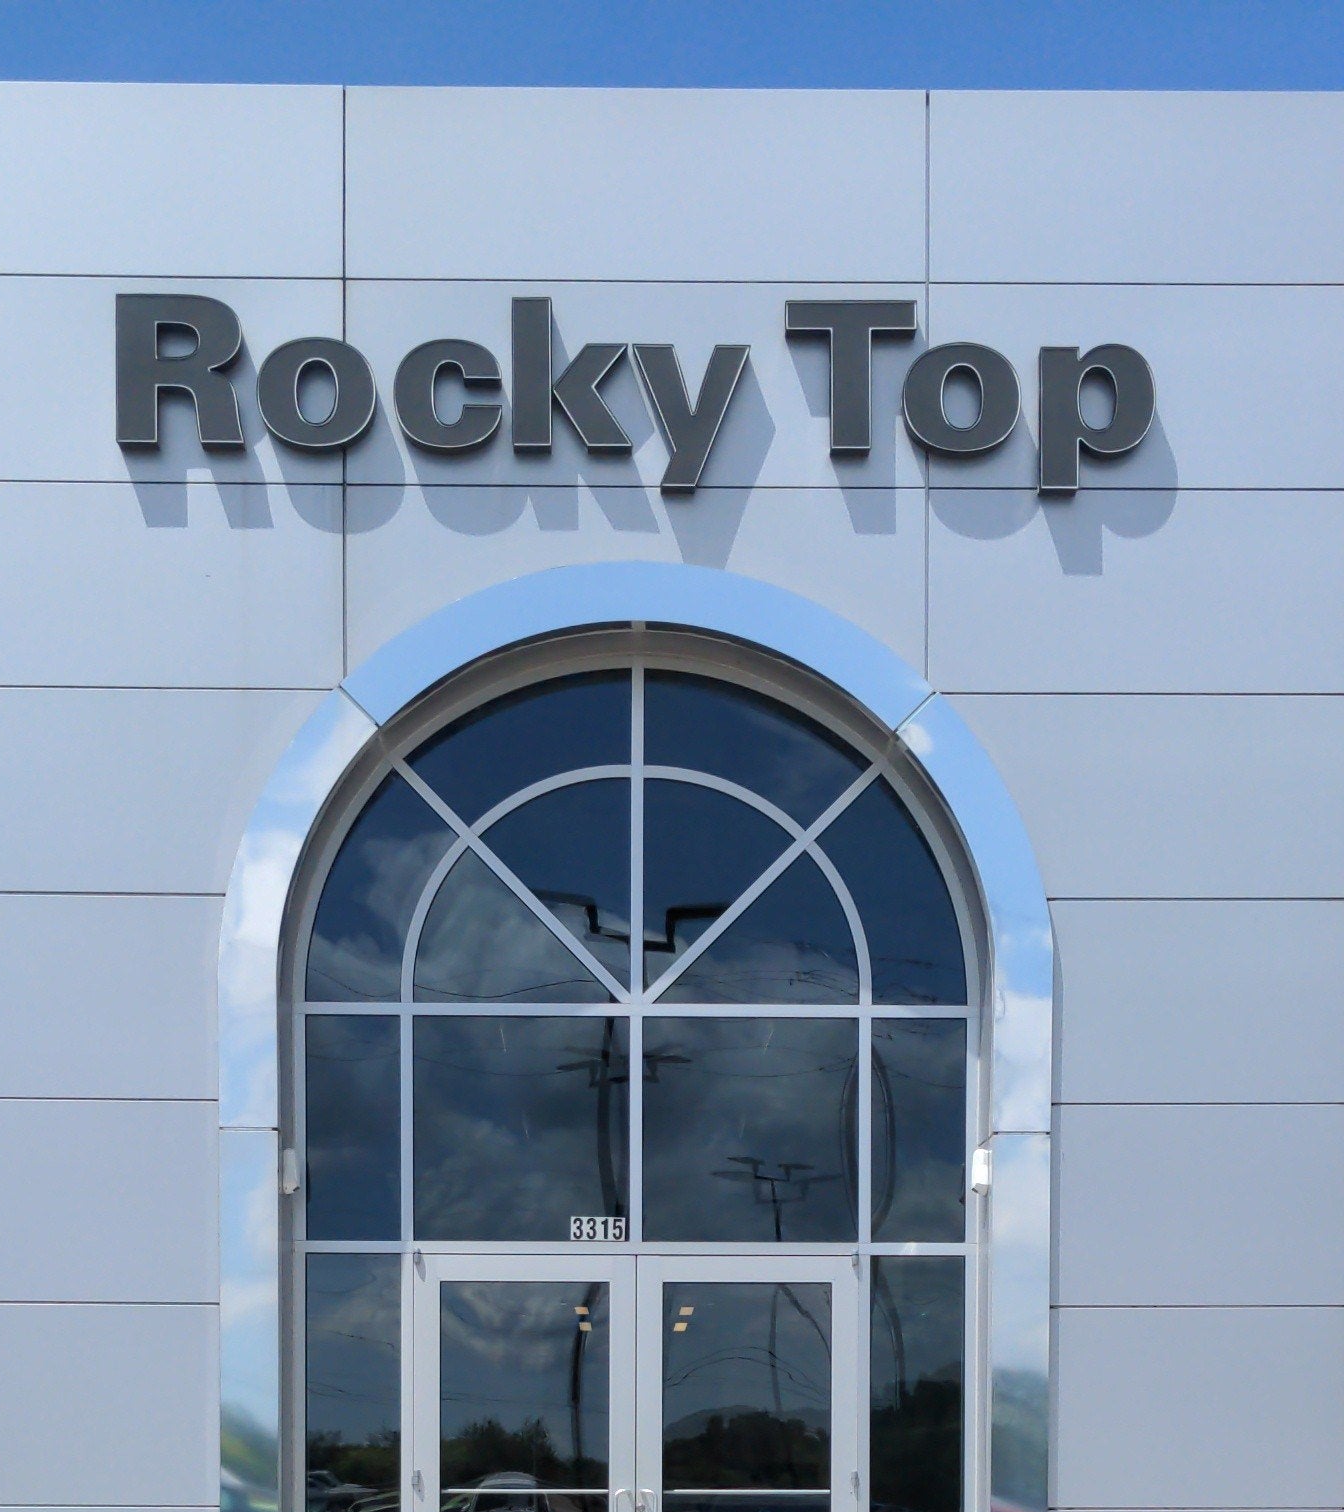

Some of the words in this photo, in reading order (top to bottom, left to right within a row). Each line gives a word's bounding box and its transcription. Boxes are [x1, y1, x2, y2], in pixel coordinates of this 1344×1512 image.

[116, 293, 751, 495] Rocky
[785, 300, 1156, 495] Top
[573, 1217, 623, 1240] 3315
